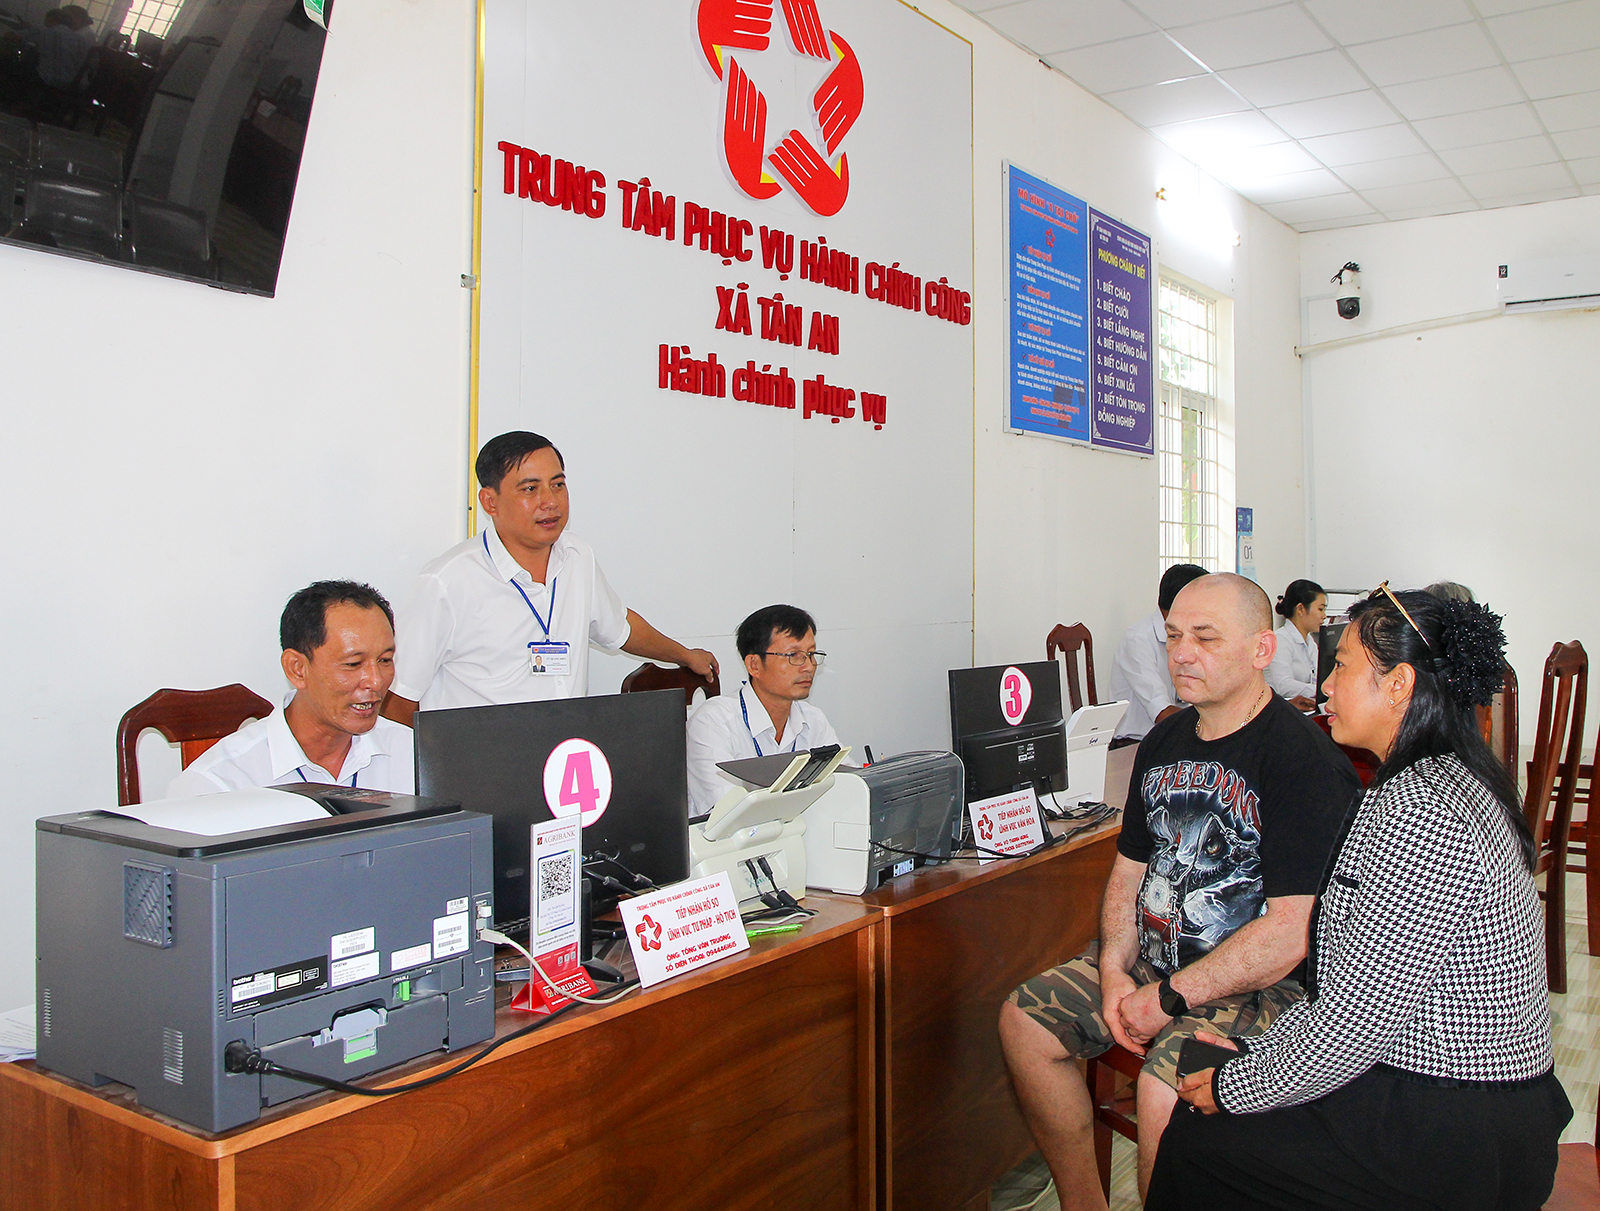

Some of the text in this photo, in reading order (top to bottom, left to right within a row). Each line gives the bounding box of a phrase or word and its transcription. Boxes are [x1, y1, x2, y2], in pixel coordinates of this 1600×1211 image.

[498, 140, 606, 219] TRUNG
[617, 176, 676, 241] TÂM
[683, 201, 753, 266] PHỤC
[759, 225, 794, 281] VỤ
[800, 236, 859, 294] HÀNH
[865, 262, 921, 312] CHÍNH
[925, 277, 971, 325] CÔNG
[1097, 279, 1131, 302] 1. BIẾT CHÀO
[1097, 298, 1102, 309] 2.
[1103, 298, 1114, 313] BIẾT
[757, 293, 802, 346] TÂN
[808, 311, 839, 355] AN
[1097, 316, 1102, 328] 3.
[1103, 317, 1114, 332] BIẾT
[1130, 328, 1145, 343] NGHE
[1096, 335, 1102, 347] 4.
[1103, 335, 1114, 350] BIẾT
[1097, 353, 1103, 366] 5.
[1103, 353, 1114, 369] BIẾT
[658, 344, 887, 430] Hành chính phục vụ
[1097, 372, 1103, 384] 6.
[1103, 372, 1114, 387] BIẾT
[1115, 377, 1126, 390] XIN
[1097, 391, 1103, 403] 7.
[1104, 390, 1115, 406] BIẾT
[1128, 399, 1146, 415] TRỌNG
[1244, 545, 1253, 560] 01
[1004, 674, 1022, 718] 3
[559, 751, 600, 813] 4
[1141, 760, 1262, 833] FREEDOM
[544, 831, 575, 844] AGRIBANK
[675, 904, 687, 920] TIẾP
[687, 900, 704, 916] NHẬN
[666, 928, 682, 941] LĨNH
[699, 915, 713, 931] PHÁP
[723, 909, 737, 923] TỊCH
[232, 975, 253, 985] brother
[554, 977, 587, 995] RIBANK
